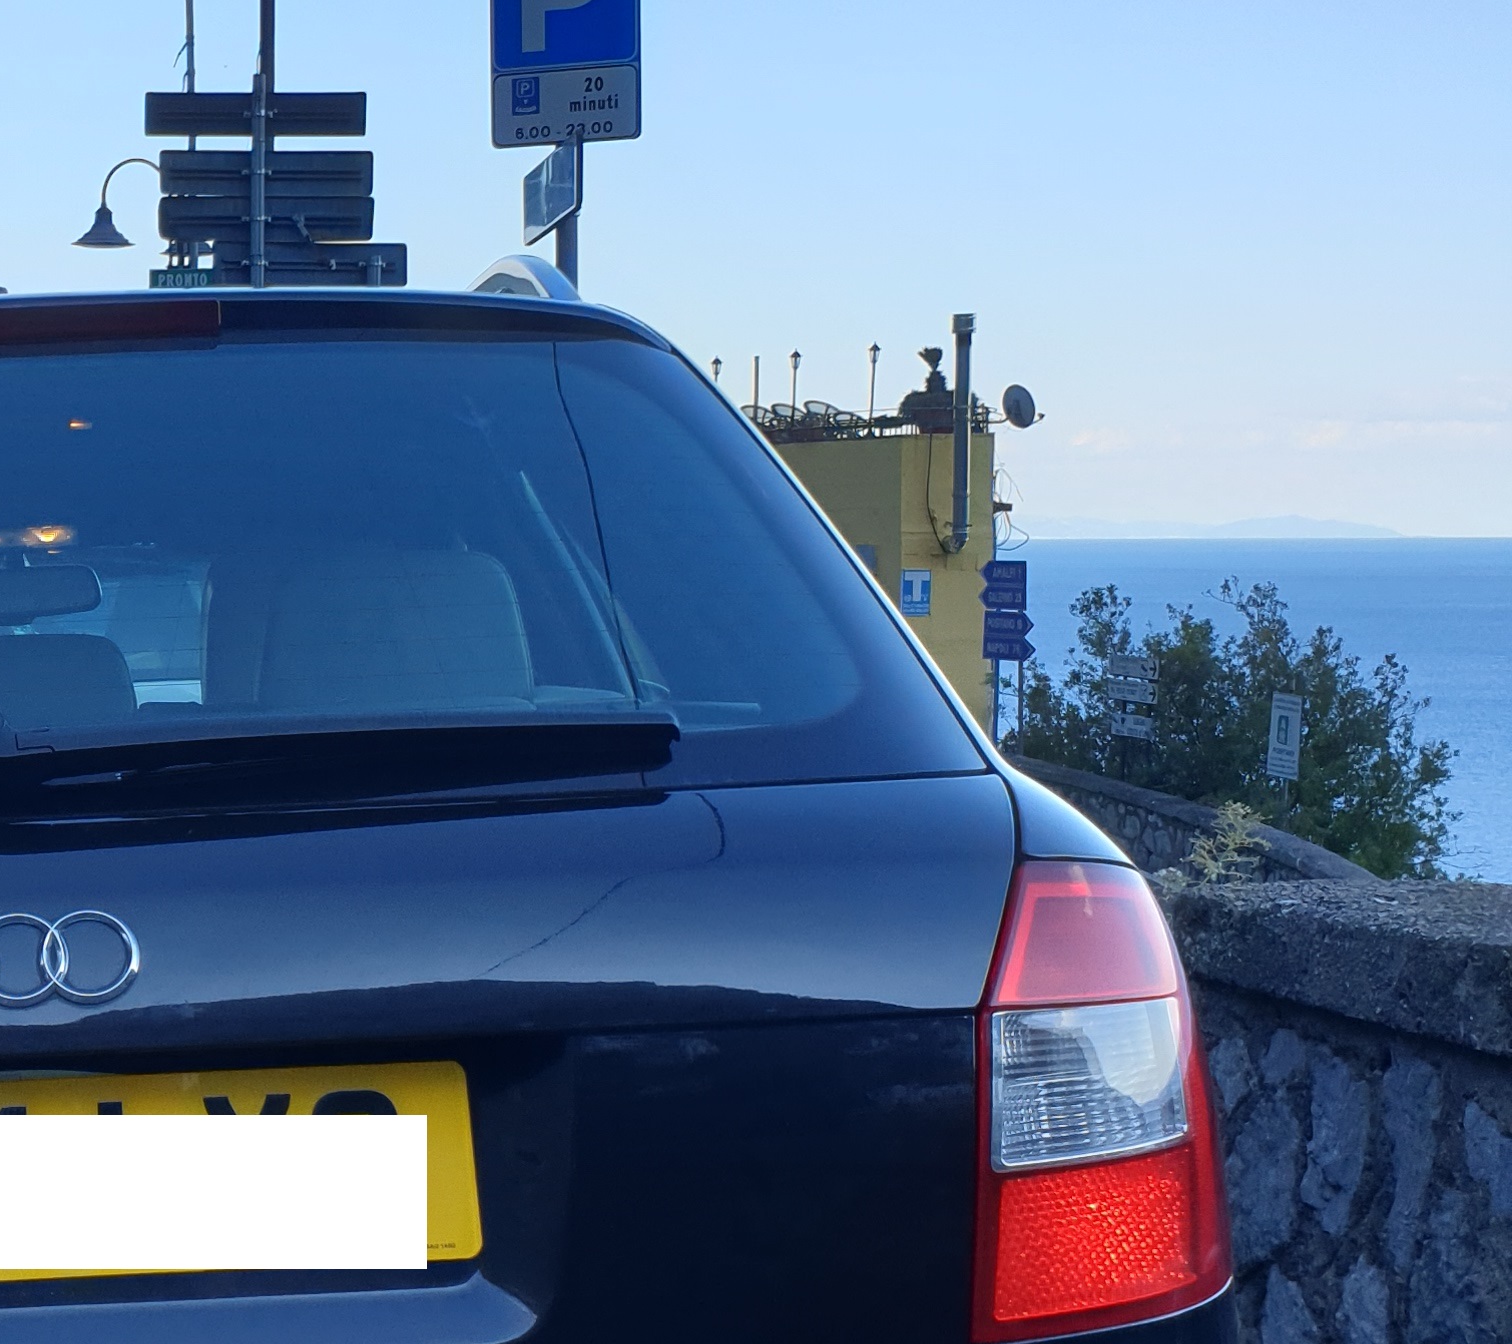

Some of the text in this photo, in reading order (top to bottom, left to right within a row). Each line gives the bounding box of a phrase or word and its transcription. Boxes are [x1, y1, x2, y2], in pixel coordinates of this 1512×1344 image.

[584, 76, 604, 93] 20
[569, 93, 619, 113] minuti
[157, 272, 208, 287] PRONTO
[904, 571, 930, 602] T
